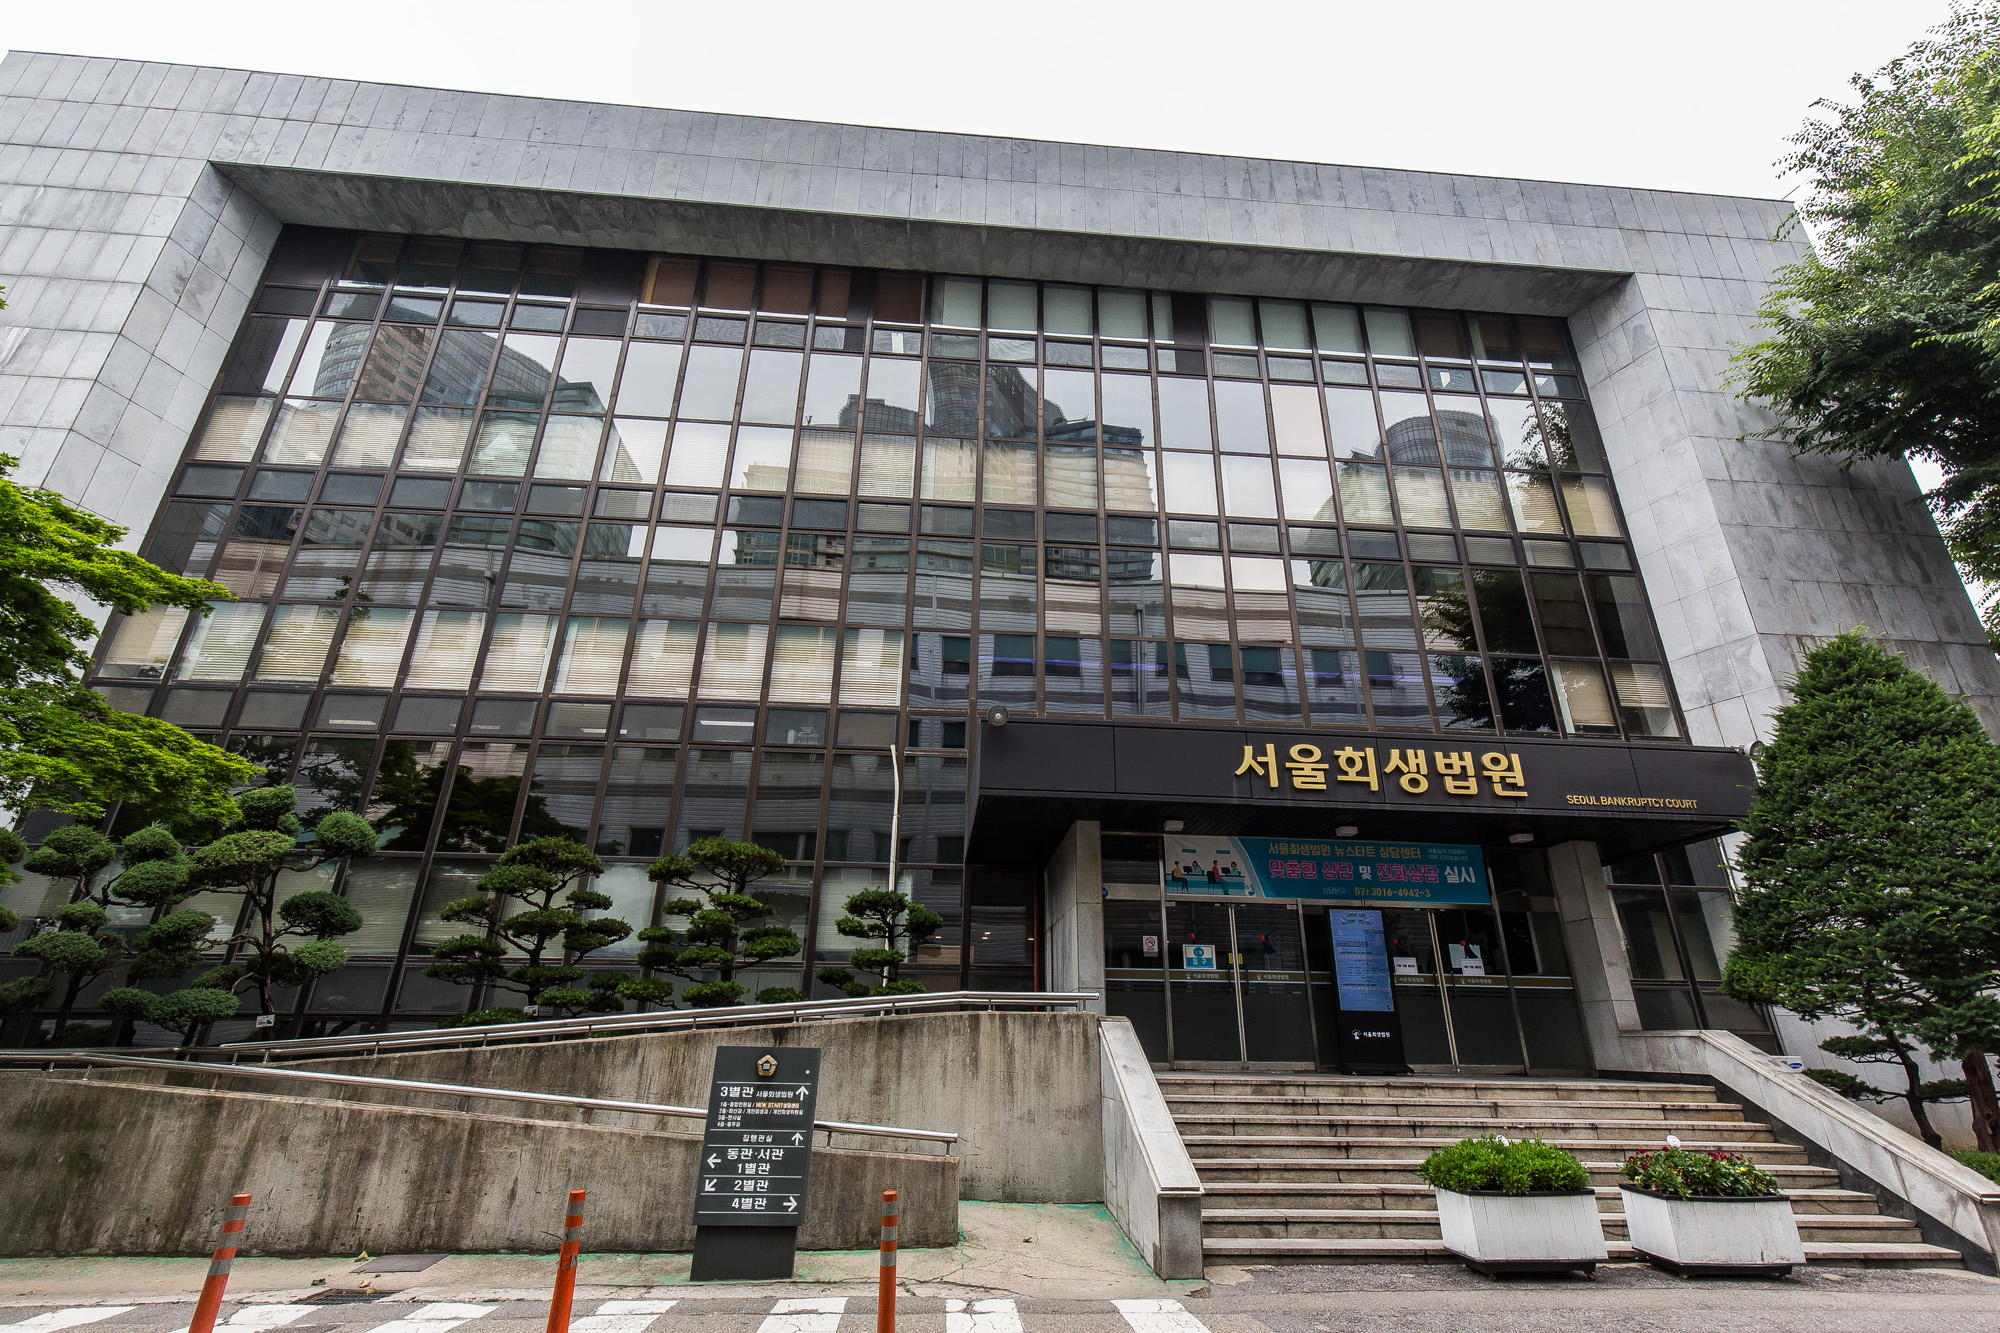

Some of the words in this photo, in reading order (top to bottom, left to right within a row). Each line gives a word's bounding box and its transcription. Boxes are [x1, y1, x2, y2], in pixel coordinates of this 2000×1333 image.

[1235, 743, 1528, 797] 서울회생법원
[1566, 795, 1599, 806] SEOUL
[1601, 796, 1664, 808] BANKRUPTCY
[1665, 798, 1698, 809] COURT
[1268, 842, 1331, 856] 서울회생법원
[1334, 845, 1376, 857] 뉴스타트
[1380, 846, 1421, 859] 상담센터
[1269, 859, 1317, 879] 맞춤형
[1322, 861, 1354, 880] 상담
[1358, 865, 1372, 880] 및
[1376, 863, 1439, 883] 전화상담
[1444, 866, 1476, 883] 실시
[1371, 887, 1431, 898] 3016-4942~3
[720, 1086, 754, 1098] 3별관
[756, 1090, 794, 1098] 서울회생법원
[742, 1134, 773, 1142] 집행관실
[737, 1162, 771, 1175] 1별관
[733, 1179, 769, 1192] 2별관
[731, 1197, 767, 1210] 4별관
